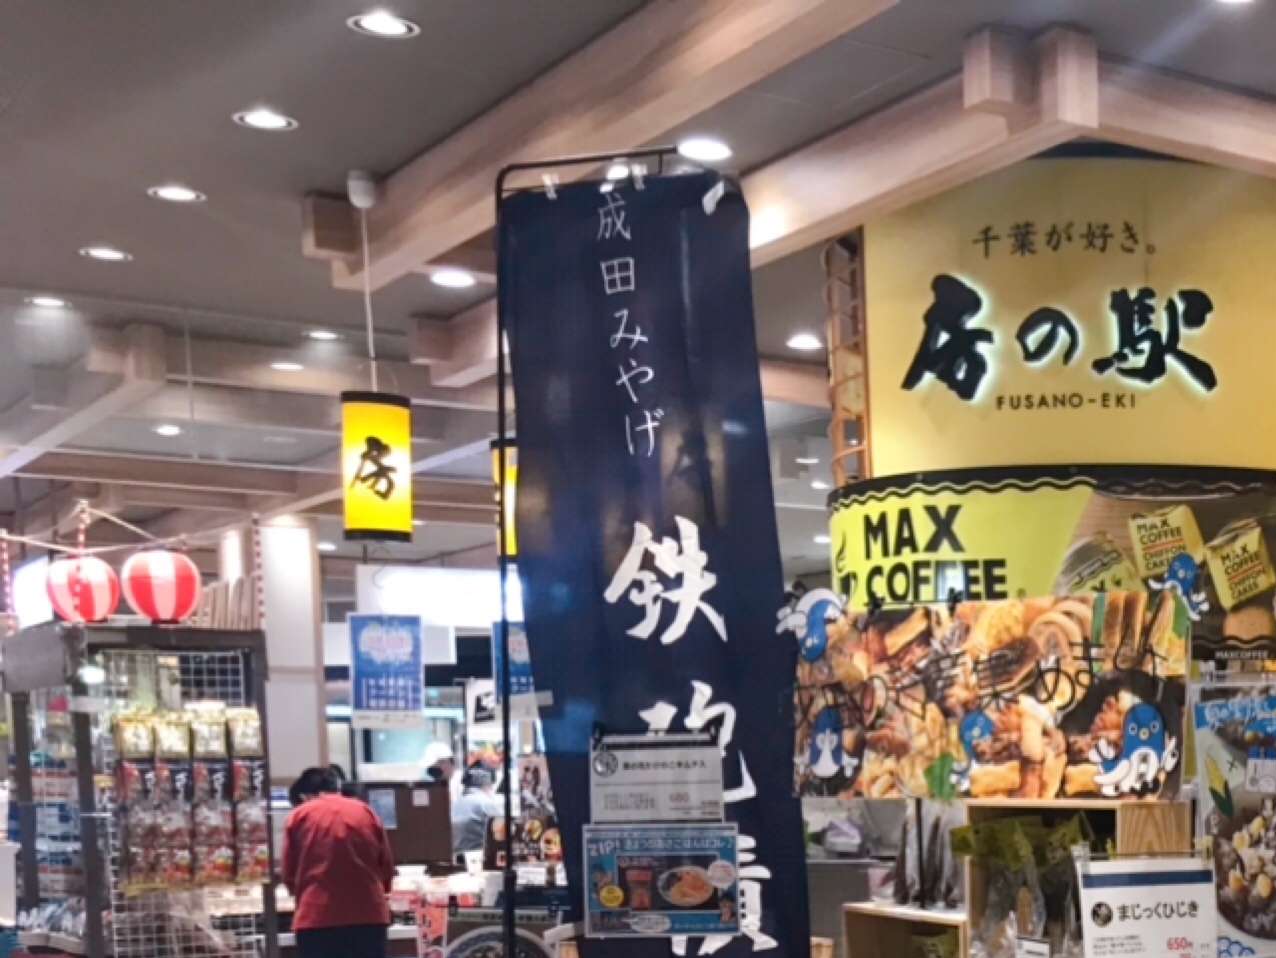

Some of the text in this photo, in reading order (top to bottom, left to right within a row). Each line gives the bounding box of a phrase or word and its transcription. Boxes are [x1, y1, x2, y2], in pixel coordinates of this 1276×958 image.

[971, 221, 1160, 261] 千葉が好き。
[597, 192, 666, 458] 成田みやげ
[900, 273, 1218, 402] 房の駅
[996, 393, 1138, 411] FUSANO-EKI
[863, 504, 966, 561] MAX
[866, 557, 1009, 603] COFFEE
[1116, 901, 1200, 923] まじっくひじき
